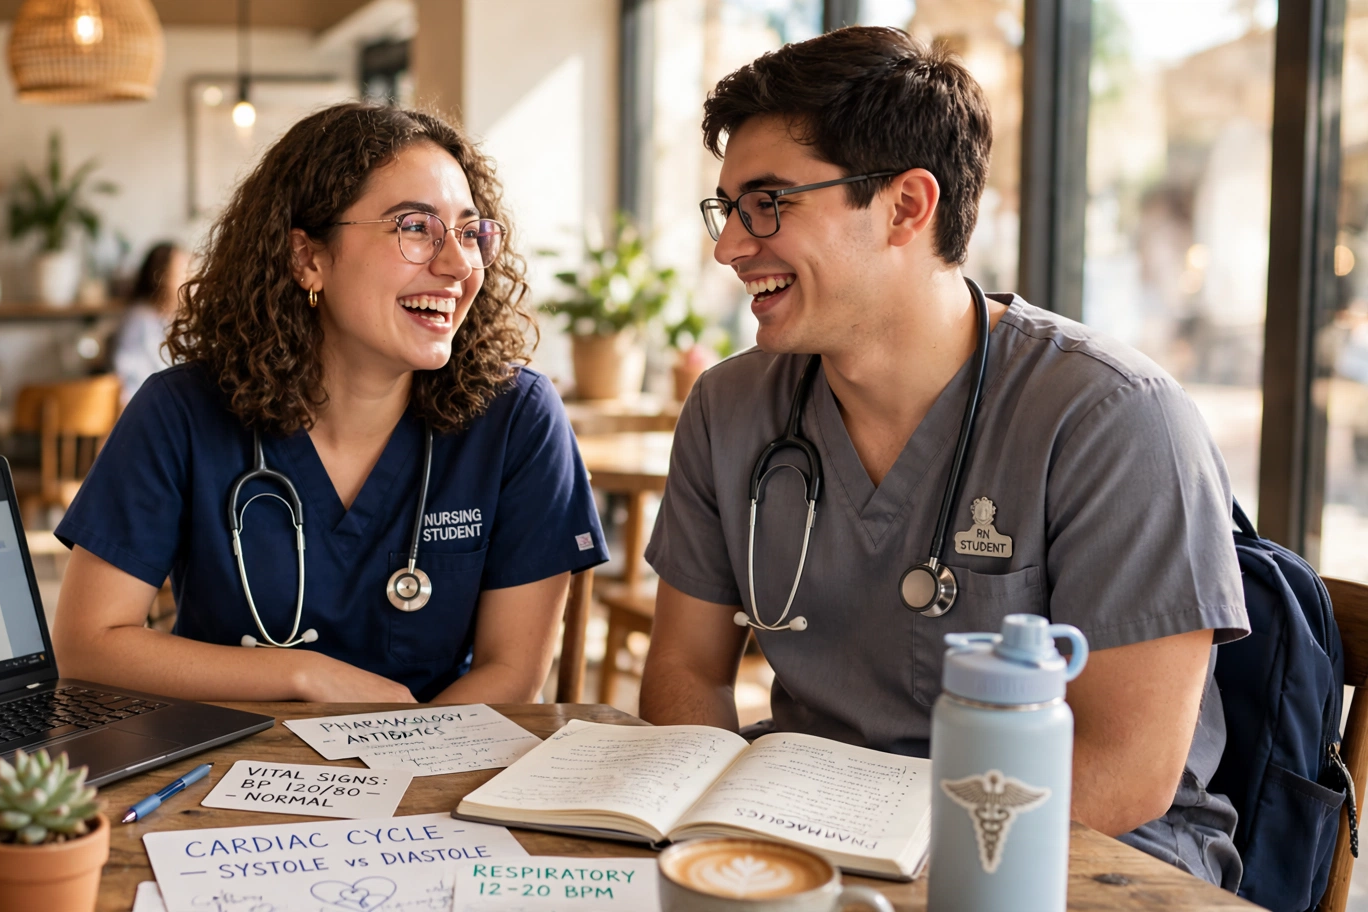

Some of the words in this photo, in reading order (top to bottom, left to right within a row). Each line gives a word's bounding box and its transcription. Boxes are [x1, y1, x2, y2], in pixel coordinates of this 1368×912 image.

[424, 508, 482, 527] NURSING
[423, 523, 483, 542] STUDENT
[977, 528, 990, 539] RN
[960, 540, 1007, 553] STUDENT
[248, 767, 305, 780] VITAL
[316, 772, 388, 786] SIGNS:
[240, 779, 271, 789] BP
[285, 782, 361, 797] 120/80
[244, 792, 334, 808] NORMAL
[185, 832, 329, 858] CARDIAC
[346, 825, 444, 845] CYCLE
[218, 857, 330, 879] SYSTOLE
[380, 845, 492, 866] DIASTOLE
[473, 864, 635, 884] RESPIRATORY
[479, 882, 551, 897] 12-20
[565, 885, 614, 899] BPM
